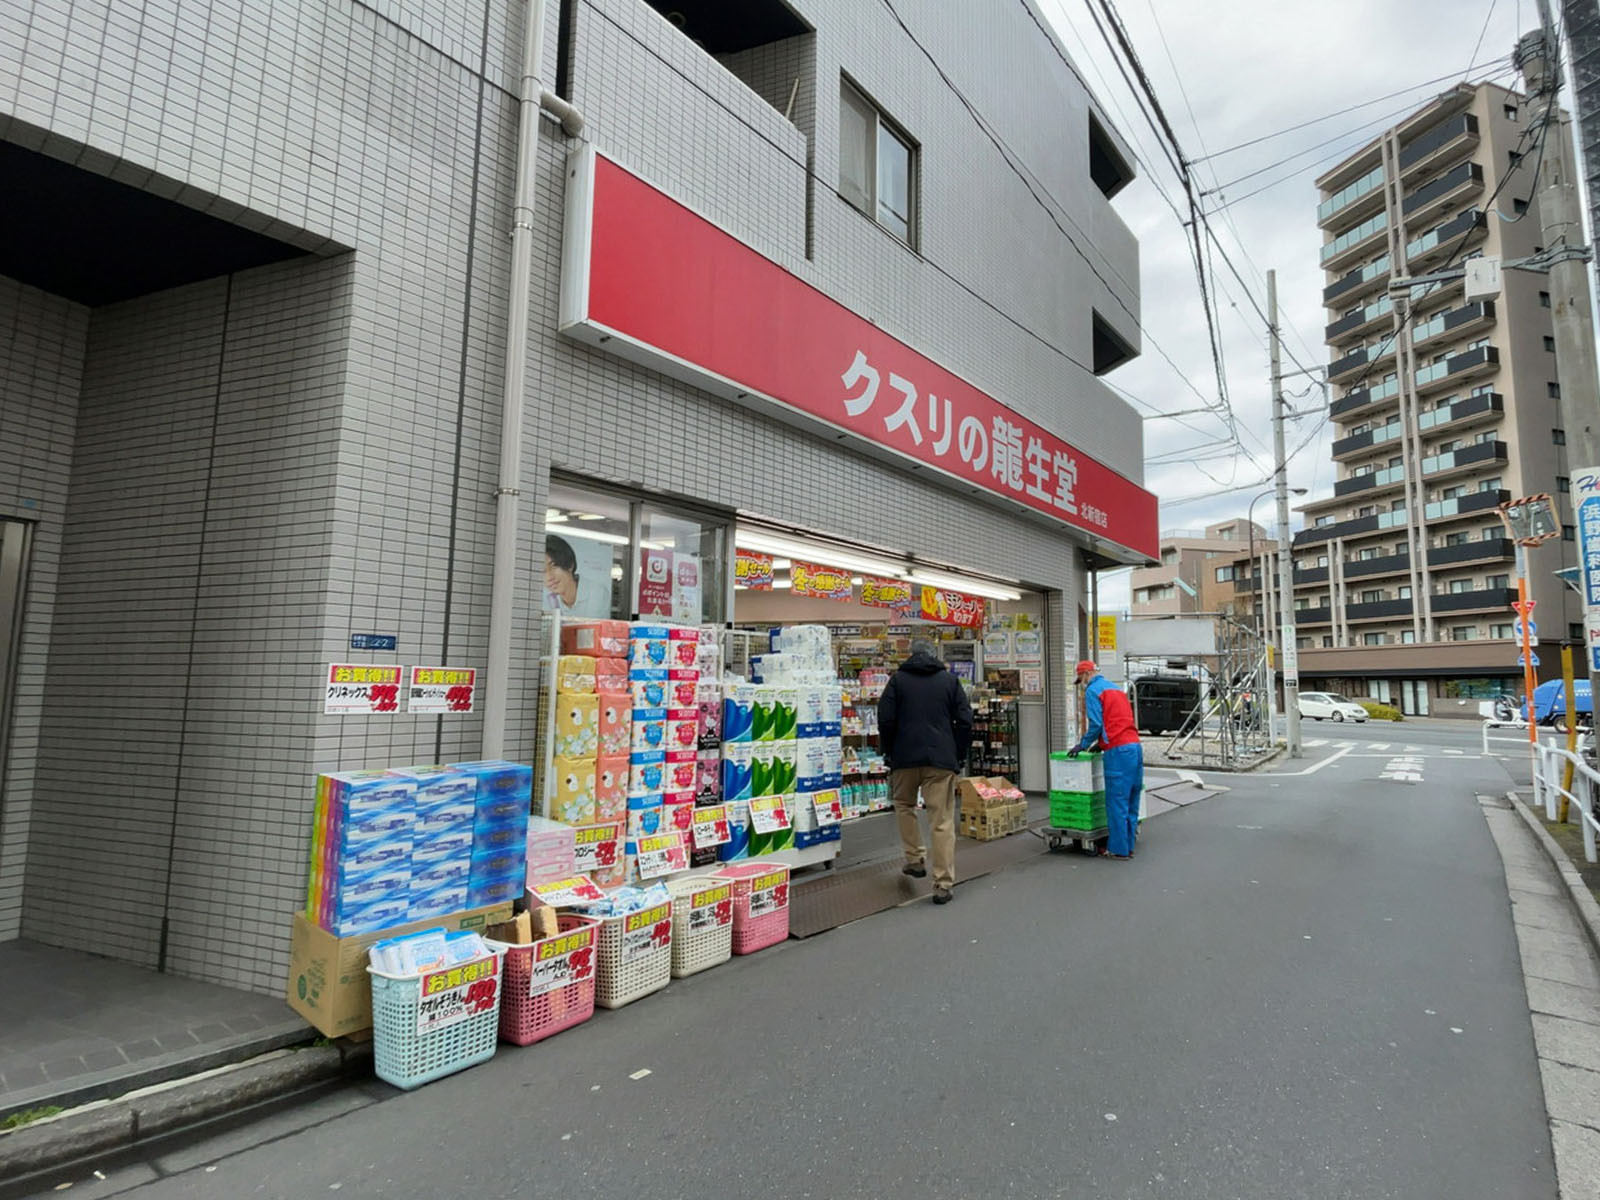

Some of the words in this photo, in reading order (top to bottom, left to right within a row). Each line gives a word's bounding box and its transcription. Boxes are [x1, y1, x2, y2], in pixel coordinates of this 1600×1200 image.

[841, 349, 1078, 515] クスリの龍生堂
[335, 667, 395, 683] お買得!!
[418, 669, 469, 684] お買得!!
[328, 687, 368, 699] クリネックス
[541, 931, 591, 960] お買得!!
[428, 959, 494, 994] お買得!!
